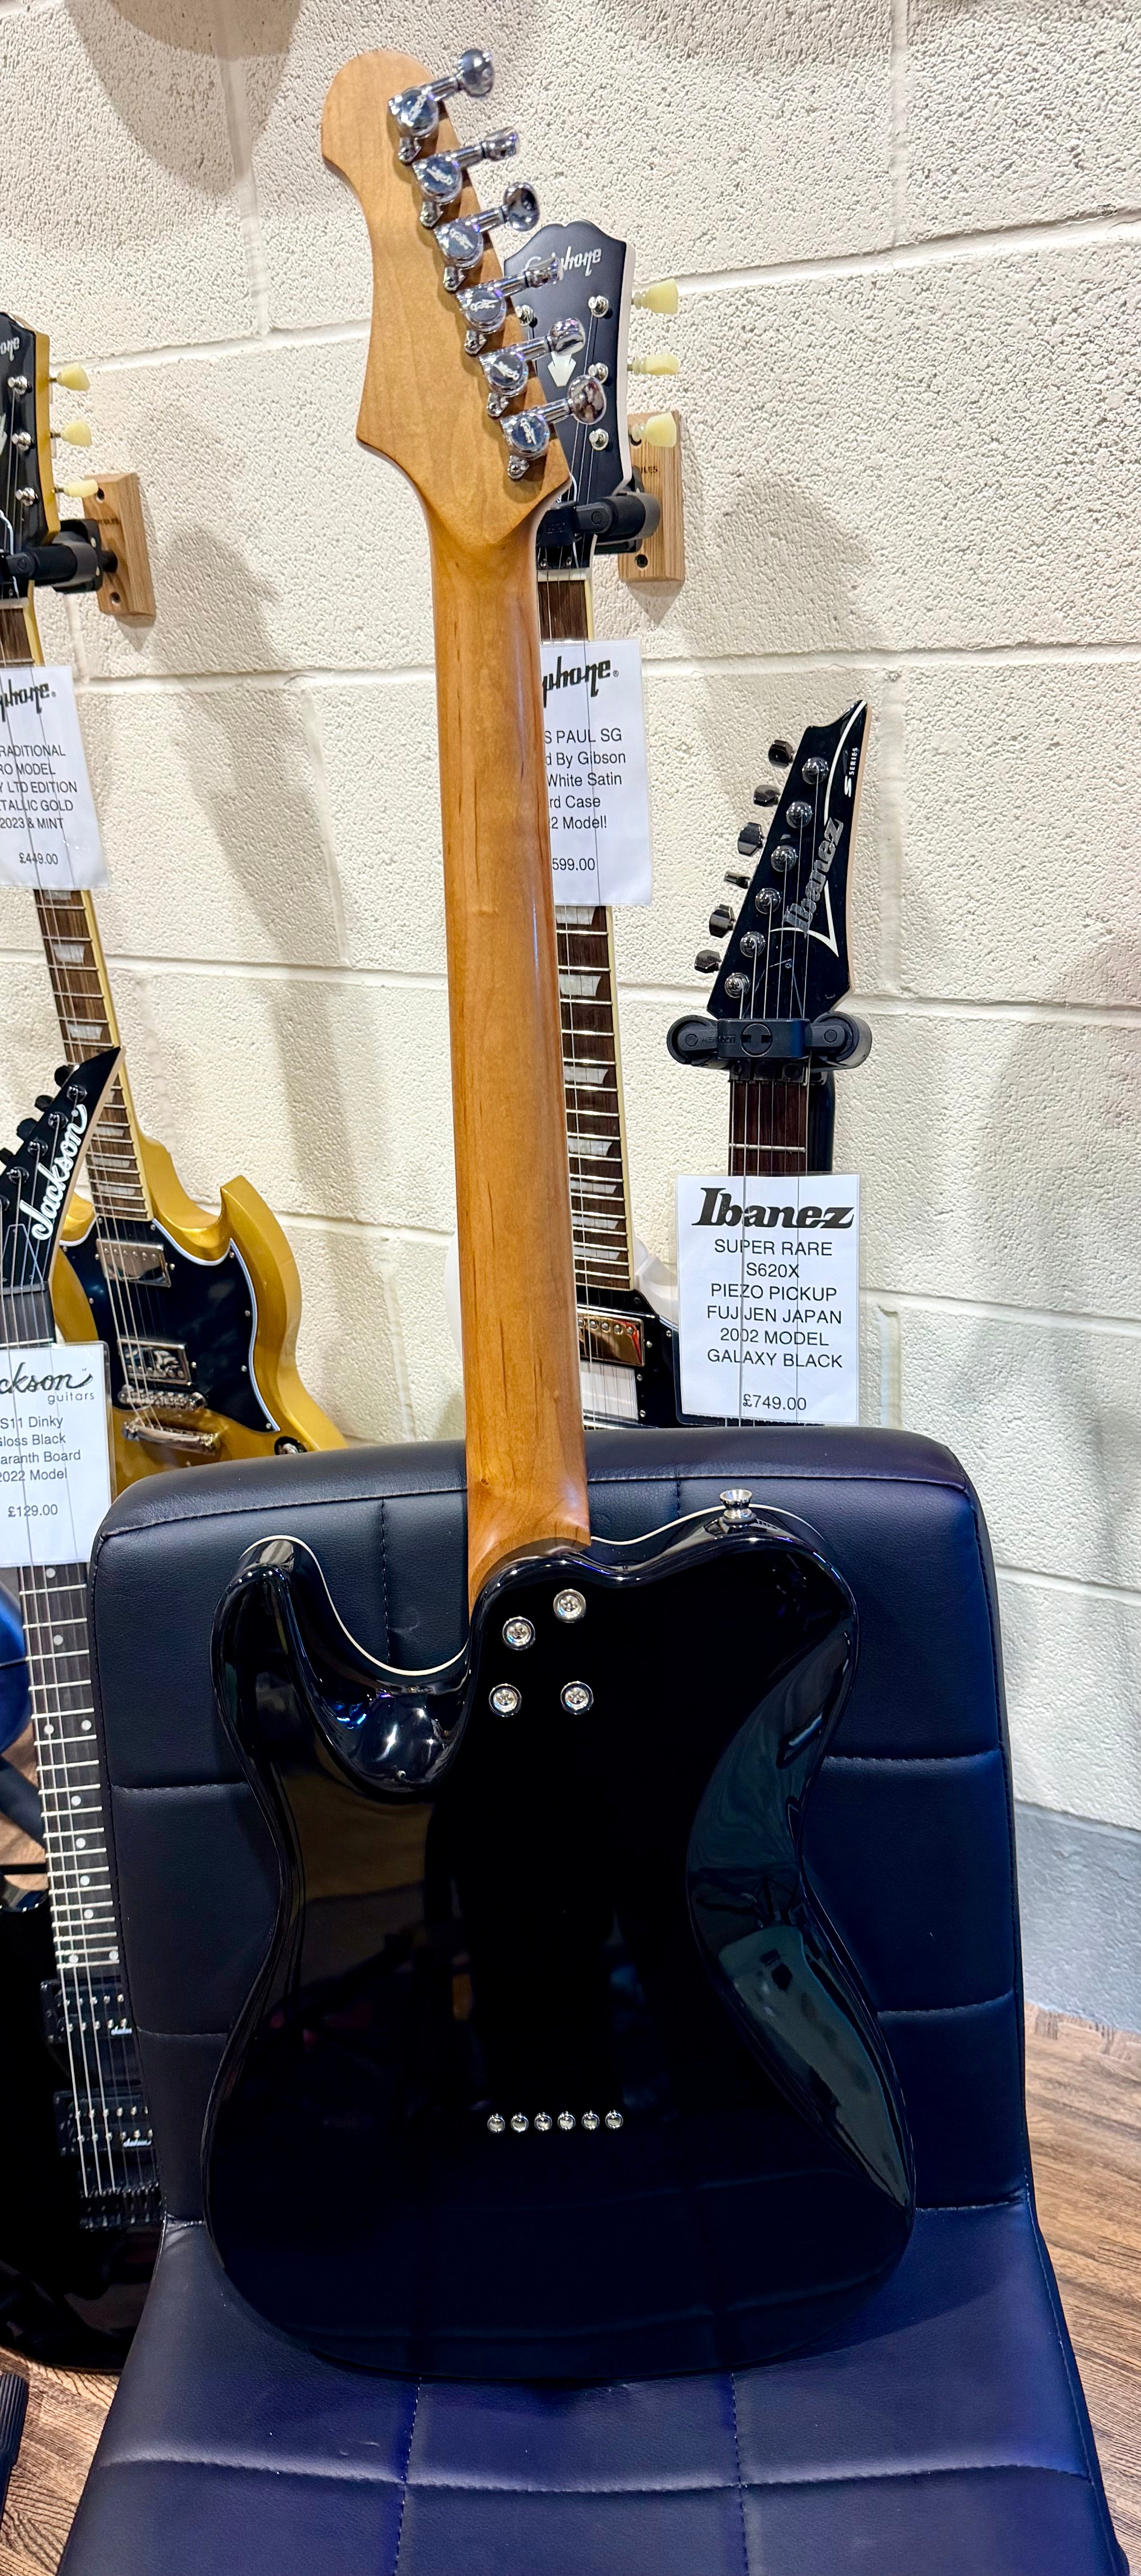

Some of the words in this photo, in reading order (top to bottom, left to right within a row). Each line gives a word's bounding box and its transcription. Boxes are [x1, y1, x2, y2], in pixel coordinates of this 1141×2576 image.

[522, 246, 602, 281] phone
[556, 729, 596, 744] PAUL
[601, 728, 622, 742] SG
[0, 745, 66, 757] RADITIONAL
[557, 752, 573, 769] By
[578, 751, 626, 765] Gibson
[848, 747, 858, 776] SERIES
[16, 763, 56, 775] MODEL
[7, 782, 28, 793] LTD
[30, 781, 78, 793] EDITION
[546, 773, 583, 787] White
[588, 772, 622, 786] Satin
[0, 800, 38, 811] TALLIC
[41, 800, 73, 811] GOLD
[566, 795, 601, 808] Case
[0, 817, 25, 828] 2023
[27, 817, 35, 828] &
[37, 818, 64, 829] MINT
[563, 815, 607, 829] Model!
[19, 852, 58, 865] £449.00
[552, 858, 595, 871] 599.00
[782, 817, 844, 939] Ibanez
[20, 1103, 87, 1241] Jackson
[691, 1187, 855, 1229] Ibanez
[714, 1239, 775, 1255] SUPER
[782, 1241, 833, 1256] RARE
[746, 1262, 800, 1278] S620X
[711, 1283, 763, 1299] PIEZO
[769, 1286, 837, 1302] PICKUP
[707, 1305, 776, 1322] FUJJEN
[782, 1309, 842, 1324] JAPAN
[720, 1328, 759, 1343] 2002
[764, 1330, 829, 1346] MODEL
[708, 1349, 777, 1366] GALAXY
[783, 1353, 842, 1368] BLACK
[47, 1392, 94, 1405] guitars
[743, 1394, 807, 1411] £749.00
[0, 1417, 23, 1429] S11
[28, 1416, 63, 1428] Dinky
[0, 1436, 28, 1447] loss
[32, 1432, 66, 1445] Black
[0, 1452, 39, 1465] aranth
[44, 1449, 81, 1462] Board
[30, 1467, 67, 1481] Model
[8, 1504, 58, 1518] £129.00
